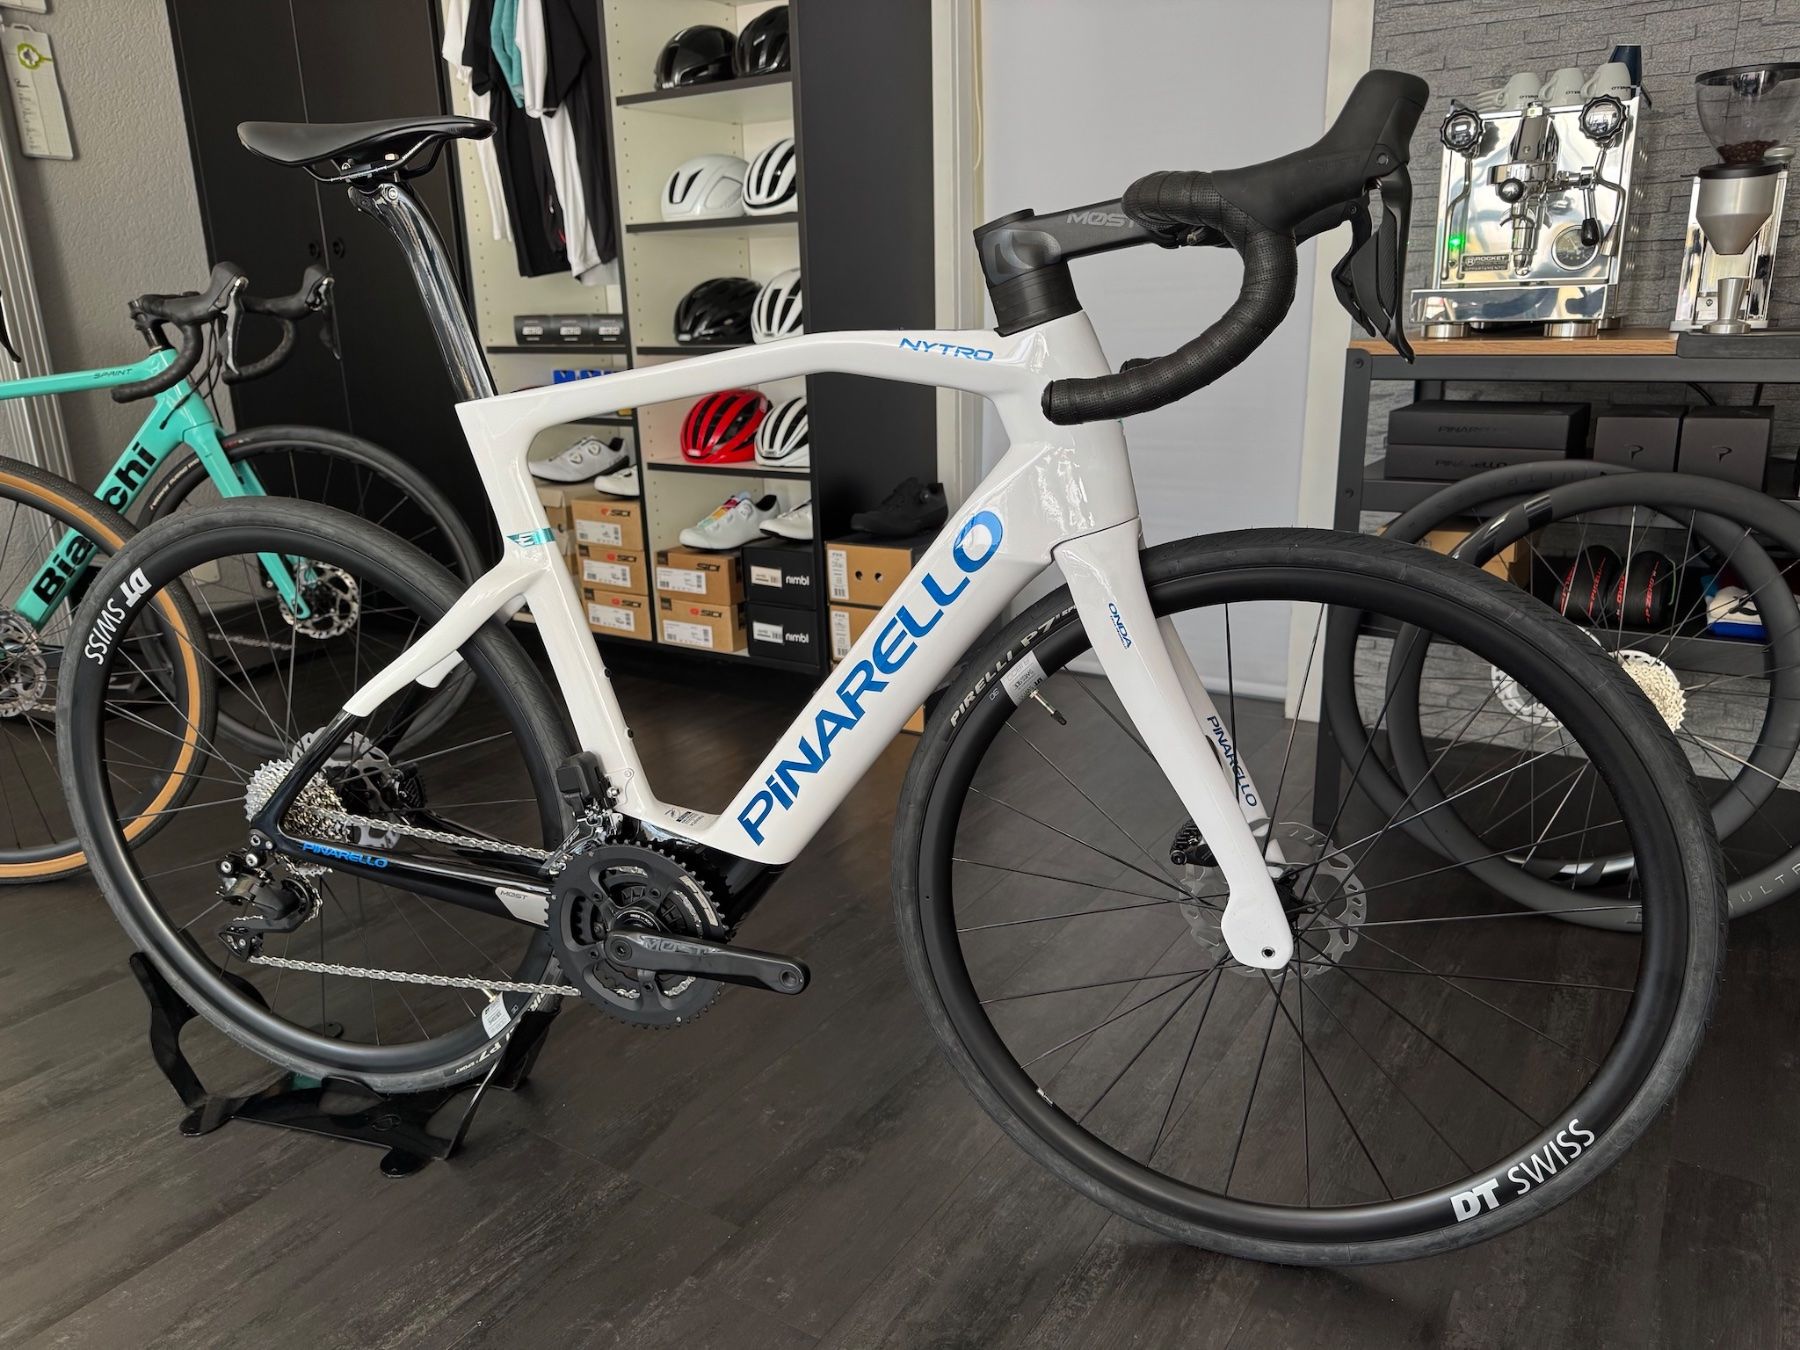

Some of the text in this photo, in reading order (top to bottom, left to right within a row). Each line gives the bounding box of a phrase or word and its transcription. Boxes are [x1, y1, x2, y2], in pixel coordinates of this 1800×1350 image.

[899, 337, 994, 362] NYTRO
[785, 575, 810, 586] nimbl
[84, 567, 152, 665] DT SWISS
[1109, 603, 1132, 648] ONDA
[785, 632, 810, 643] nimbl
[950, 650, 1013, 728] PIRELLI
[302, 841, 389, 869] PINARELLO
[1450, 1118, 1596, 1223] DT SWISS
